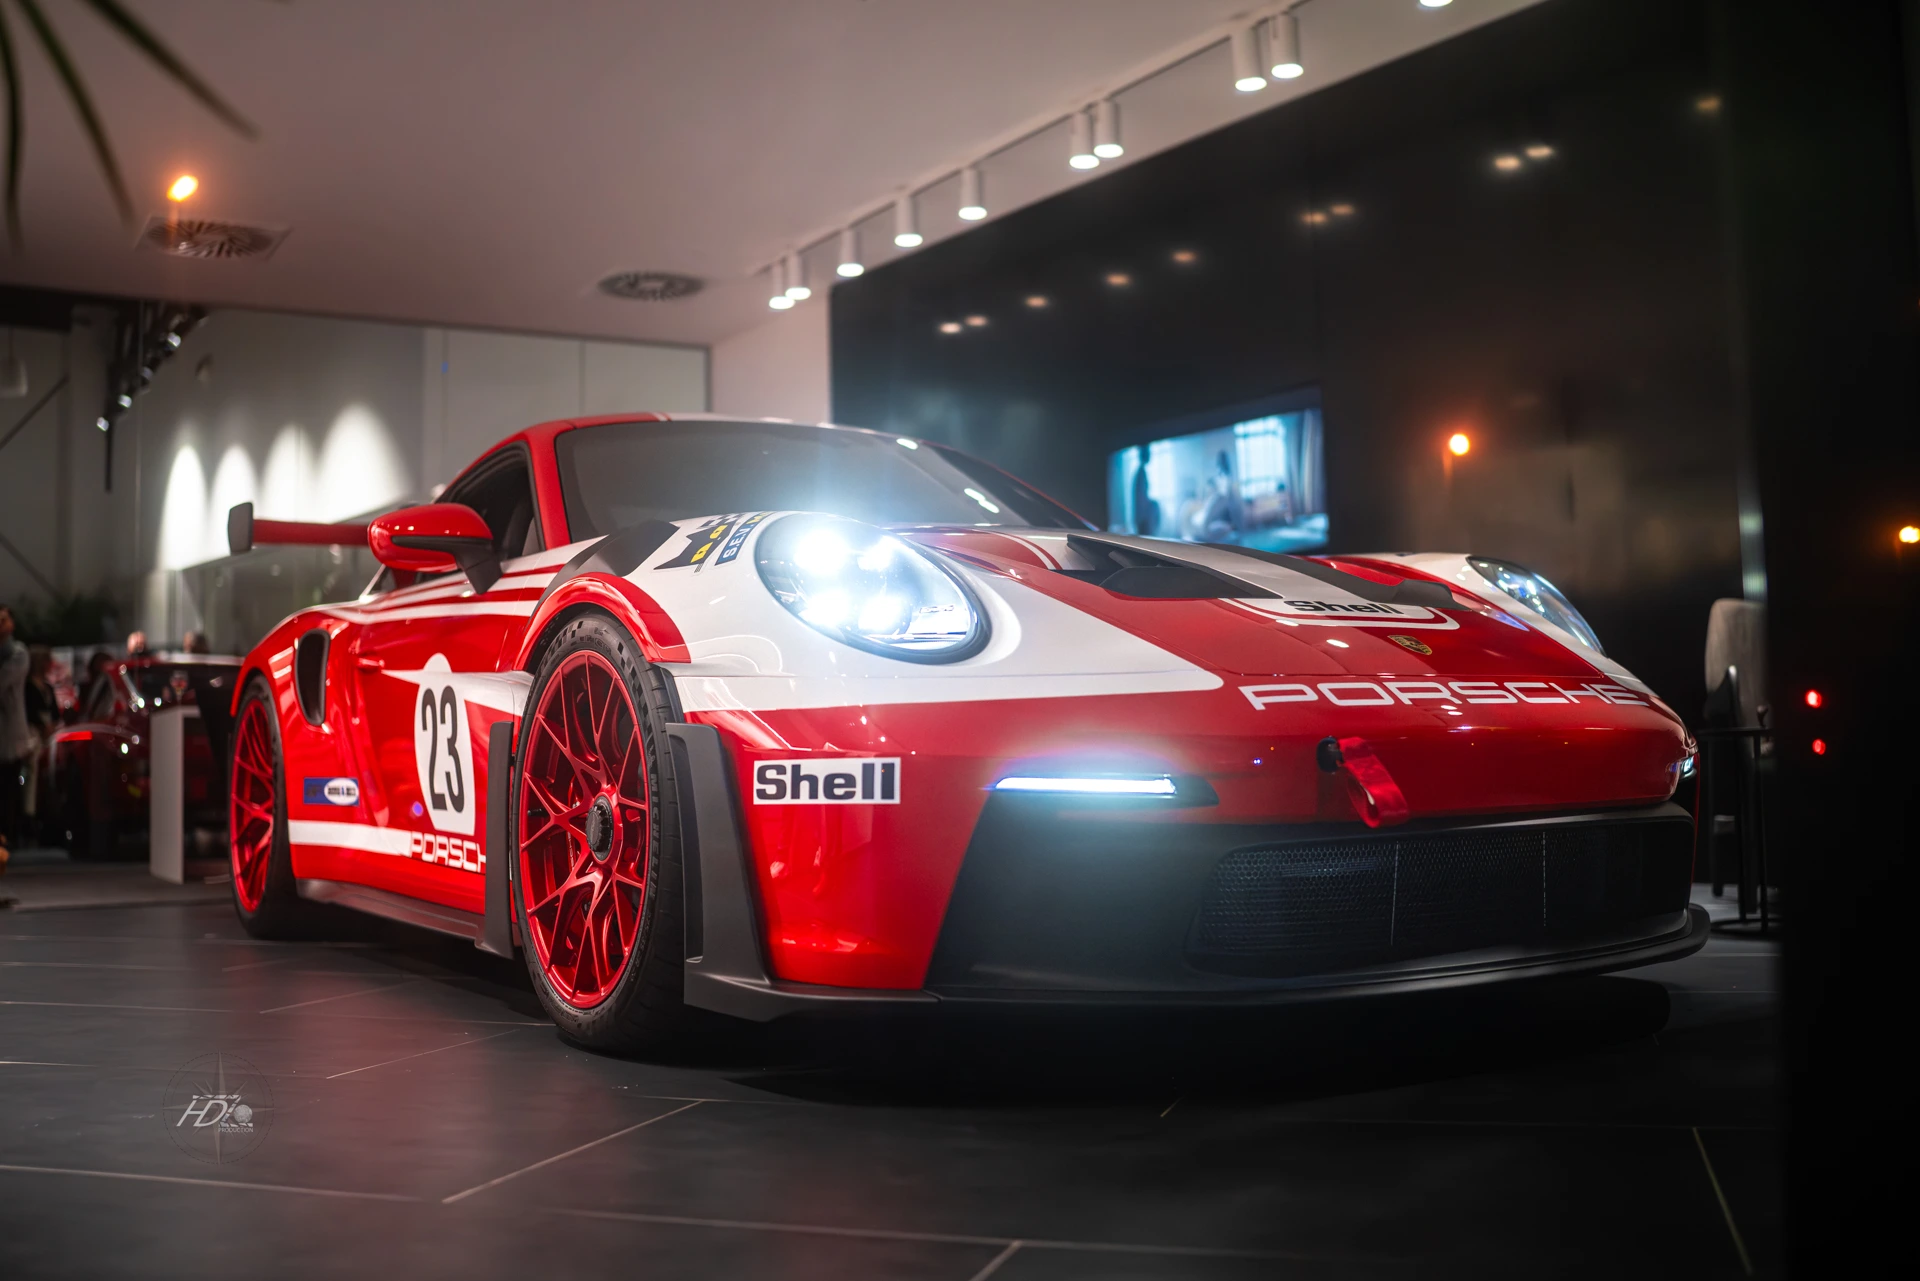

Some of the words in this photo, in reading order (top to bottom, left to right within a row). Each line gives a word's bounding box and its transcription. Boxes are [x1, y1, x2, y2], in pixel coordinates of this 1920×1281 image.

[1283, 600, 1404, 615] Shell
[1237, 682, 1650, 711] PORSCHE
[421, 685, 465, 814] 23
[756, 763, 895, 800] Shell
[650, 773, 661, 899] MICHELIN
